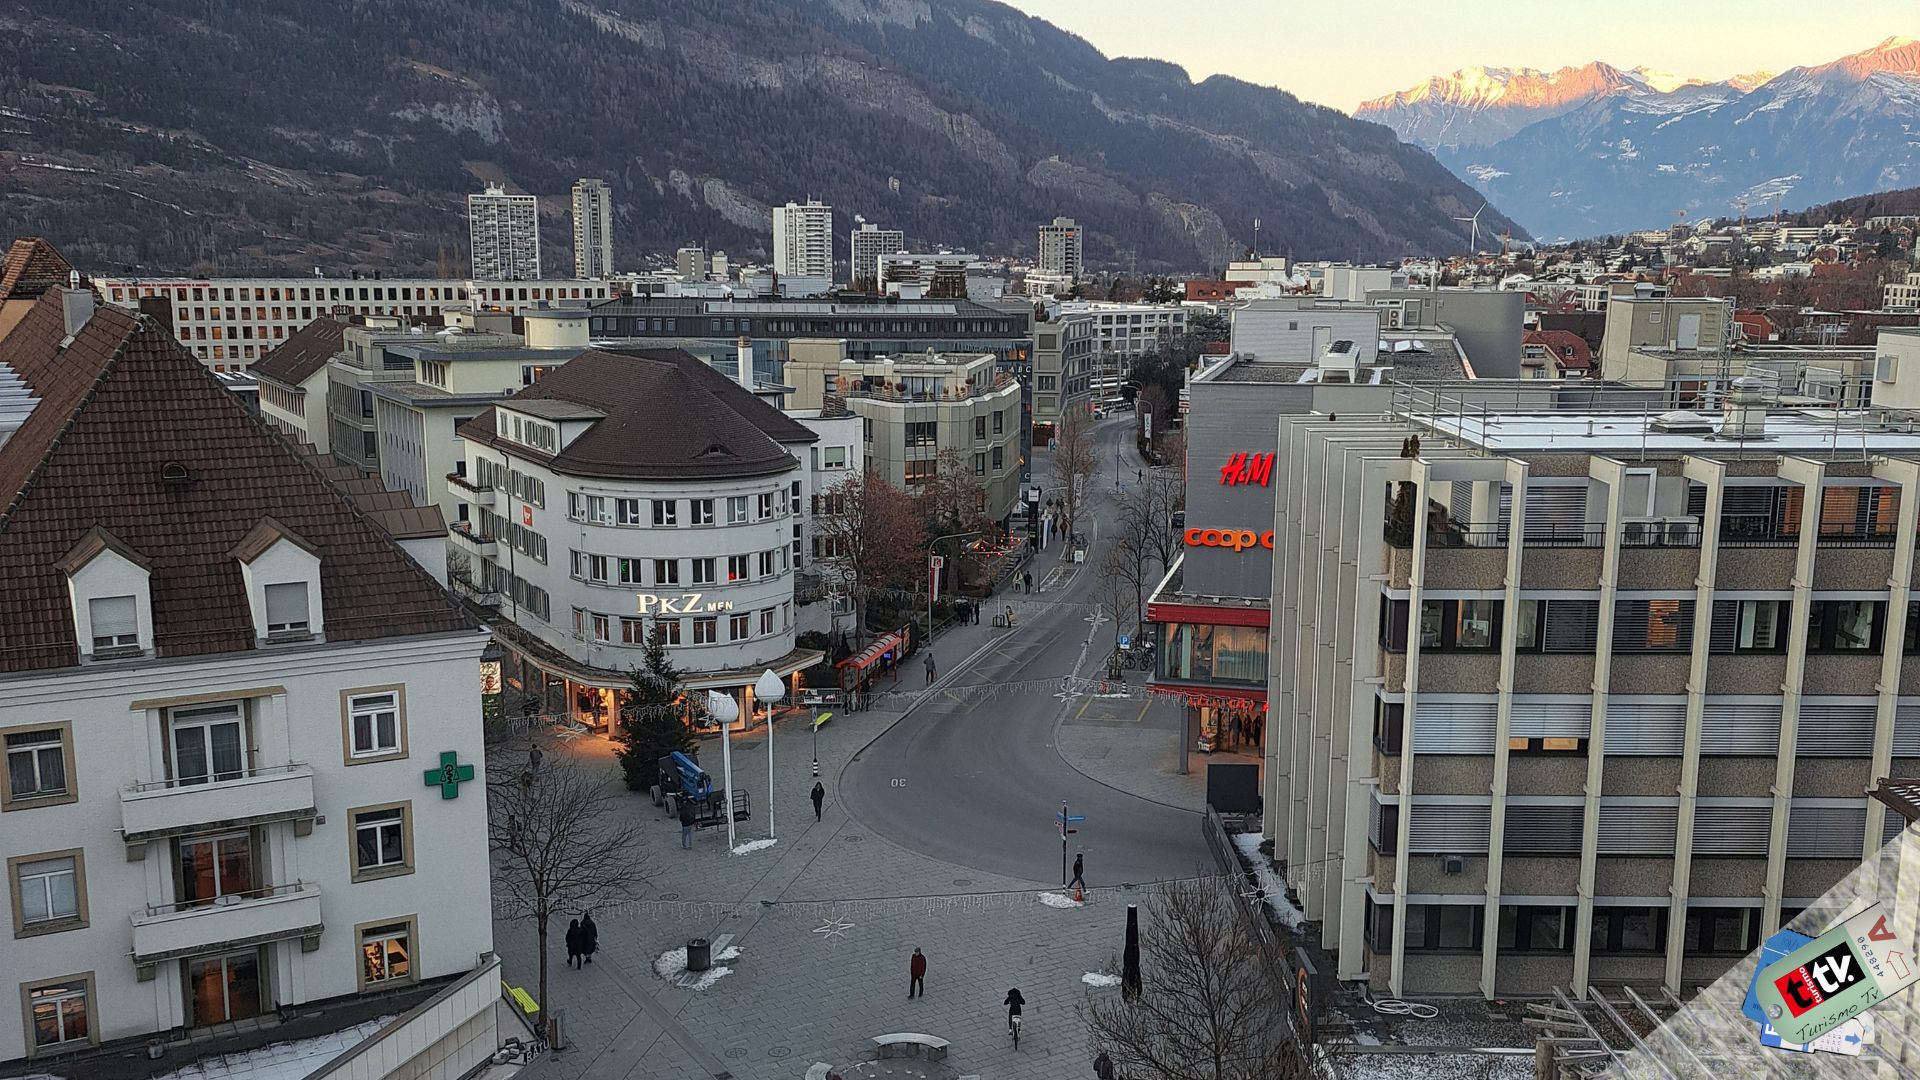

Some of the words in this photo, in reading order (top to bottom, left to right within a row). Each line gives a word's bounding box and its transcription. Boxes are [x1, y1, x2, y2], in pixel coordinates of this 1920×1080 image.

[1219, 451, 1275, 488] H&M
[1184, 528, 1257, 552] coop
[891, 778, 906, 787] 30
